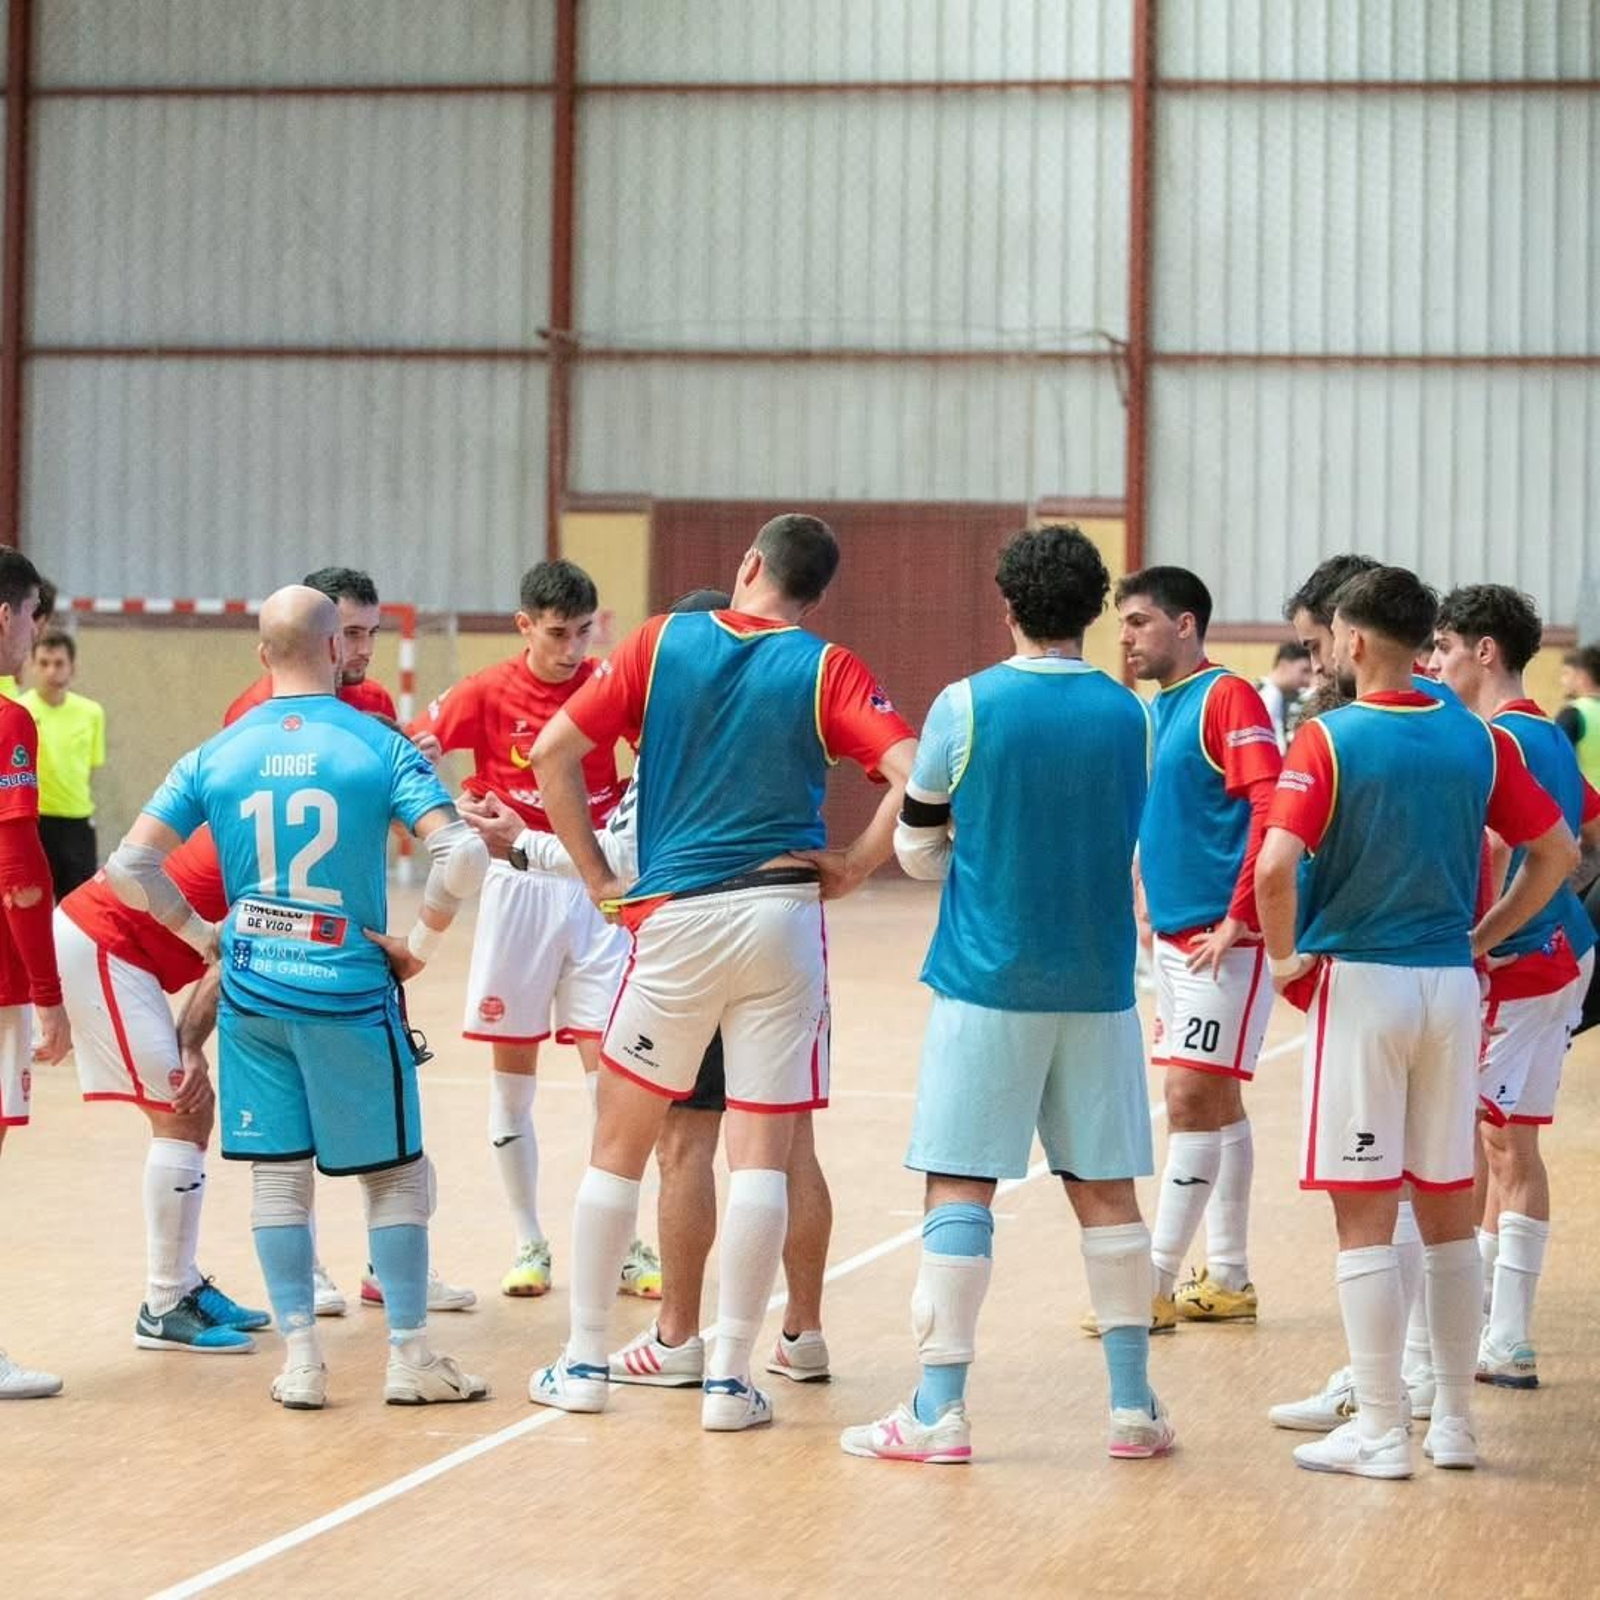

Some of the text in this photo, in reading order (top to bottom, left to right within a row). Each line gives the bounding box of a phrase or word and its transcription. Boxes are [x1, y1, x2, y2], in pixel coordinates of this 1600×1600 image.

[260, 753, 317, 777] JORGE
[240, 788, 343, 906] 12
[248, 917, 293, 932] DE VIGO
[258, 943, 307, 961] XUNTA
[254, 959, 339, 980] DE GALICIA
[1184, 1016, 1221, 1053] 20
